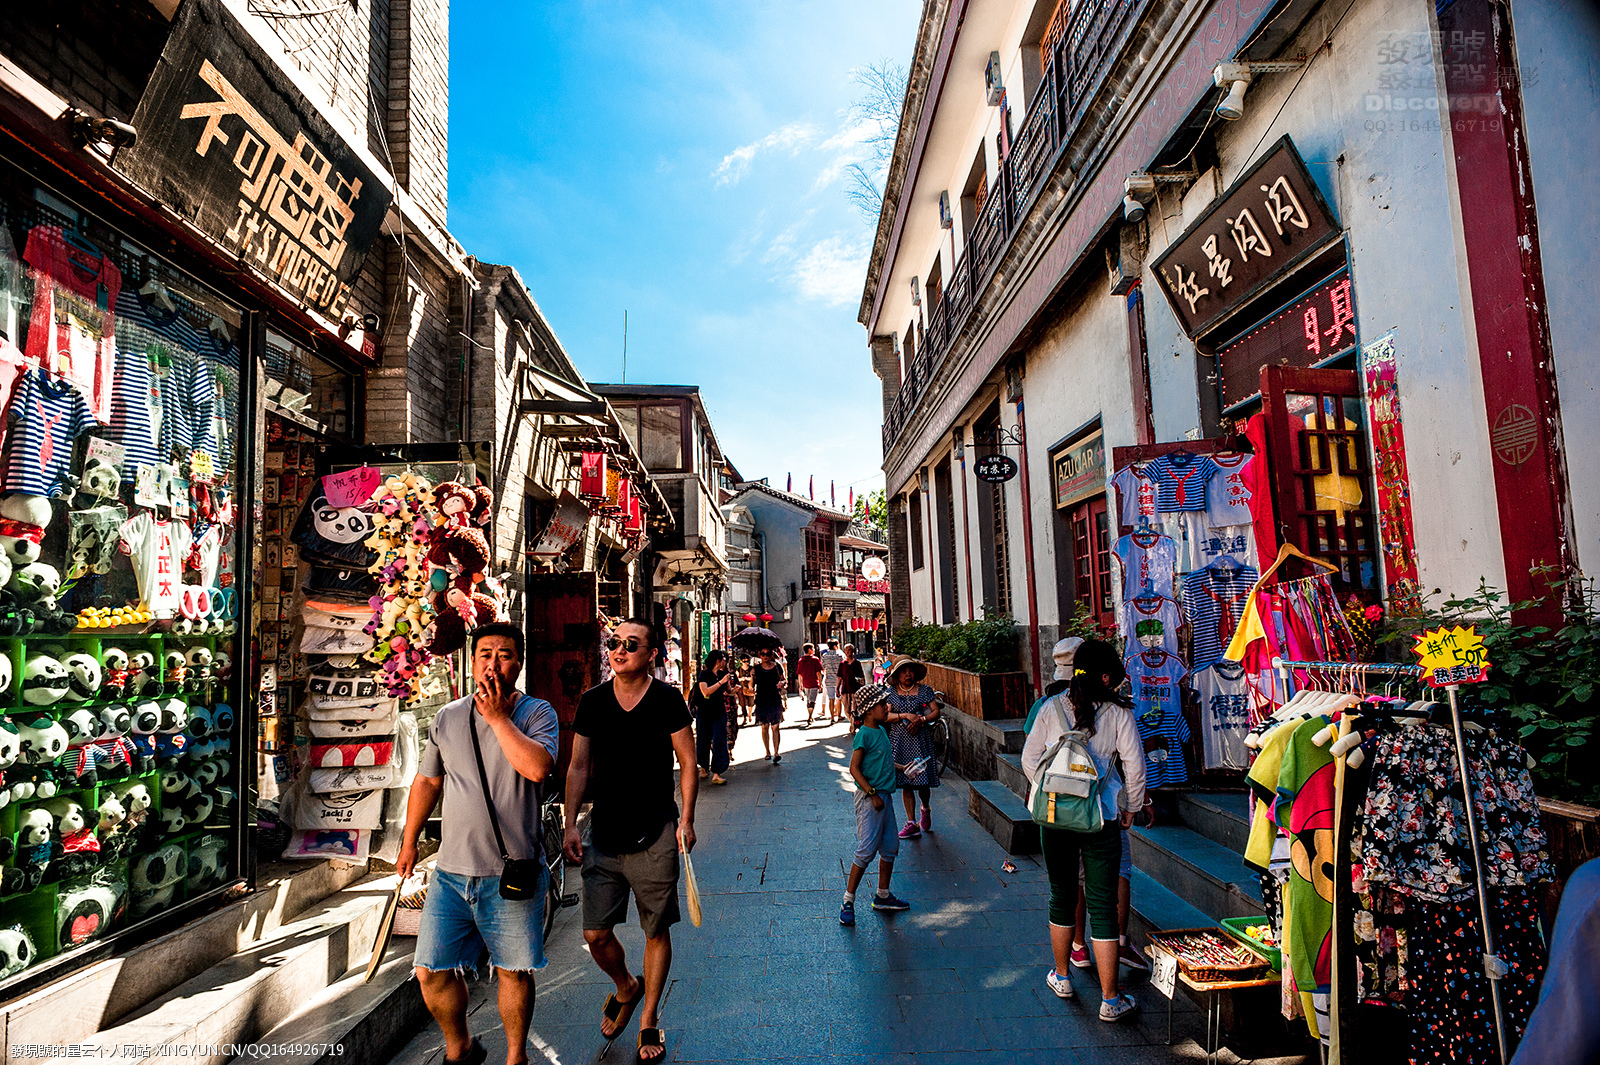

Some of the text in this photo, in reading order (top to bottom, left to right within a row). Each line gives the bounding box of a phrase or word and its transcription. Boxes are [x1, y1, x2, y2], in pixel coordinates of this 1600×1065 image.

[1174, 175, 1309, 315] 红星闪闪
[979, 463, 1011, 475] 阿苏卡
[1058, 449, 1094, 482] AZUCAR
[1138, 482, 1154, 516] 小祖宗
[157, 531, 172, 597] 小正太
[1427, 634, 1457, 659] 特价
[1452, 642, 1488, 666] 50元
[1434, 664, 1481, 685] 热卖中
[320, 809, 343, 819] Jacki
